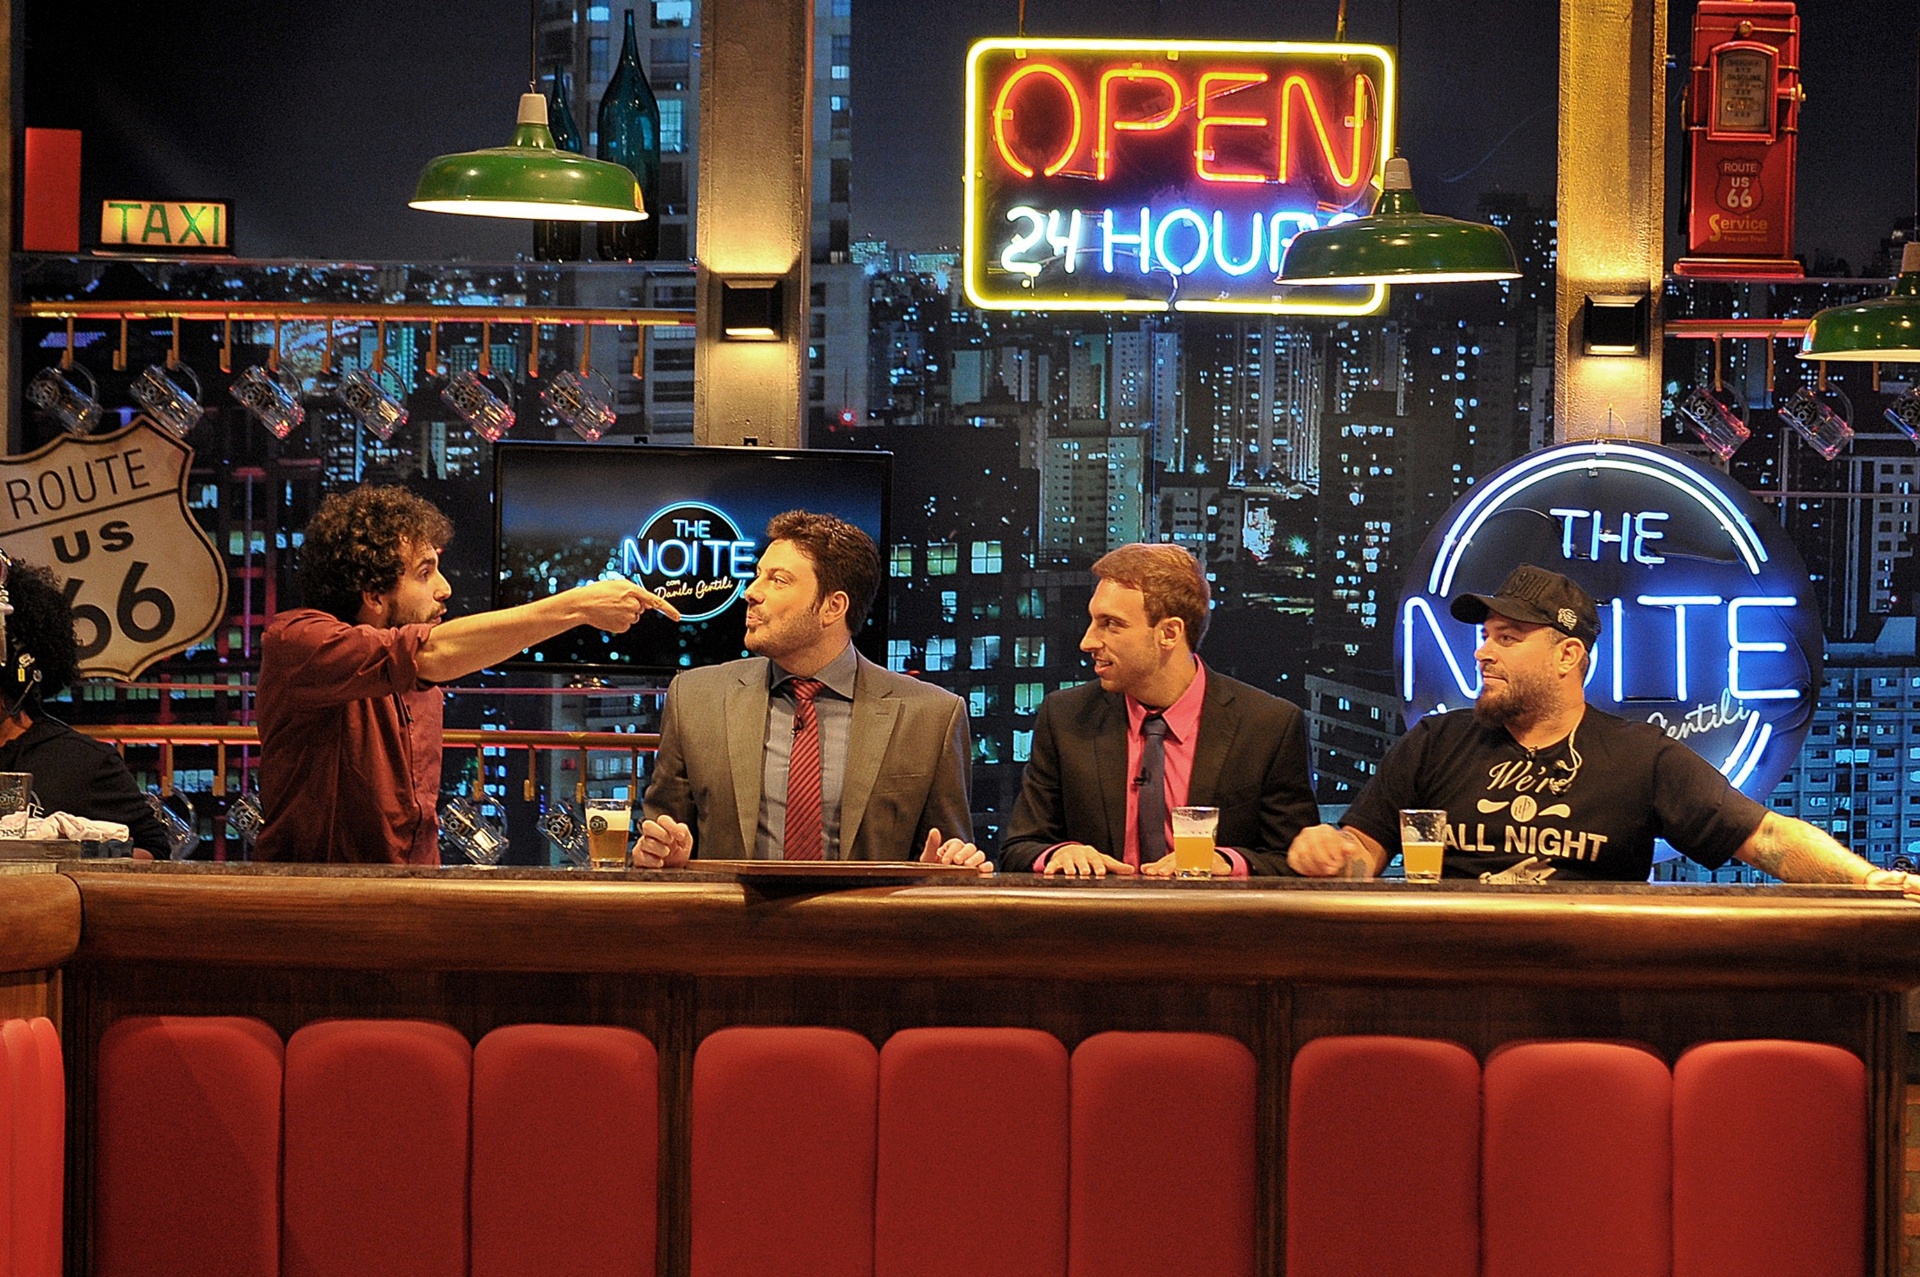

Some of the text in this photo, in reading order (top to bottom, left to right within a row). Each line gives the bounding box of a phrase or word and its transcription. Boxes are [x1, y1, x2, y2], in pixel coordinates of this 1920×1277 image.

[994, 64, 1366, 187] OPEN
[1723, 162, 1757, 173] ROUTE
[1731, 176, 1750, 188] US
[1727, 188, 1753, 208] 66
[108, 202, 220, 246] TAXI
[1001, 205, 1361, 276] 24 HOUR
[1708, 213, 1768, 242] Service
[5, 448, 150, 520] ROUTE
[51, 520, 134, 564] US
[672, 519, 711, 538] THE
[1549, 508, 1669, 564] THE
[623, 538, 756, 578] NOITE
[653, 576, 733, 600] Danilo Gentili
[1403, 595, 1801, 702] NITE
[1443, 823, 1608, 862] ALL NIGHT
